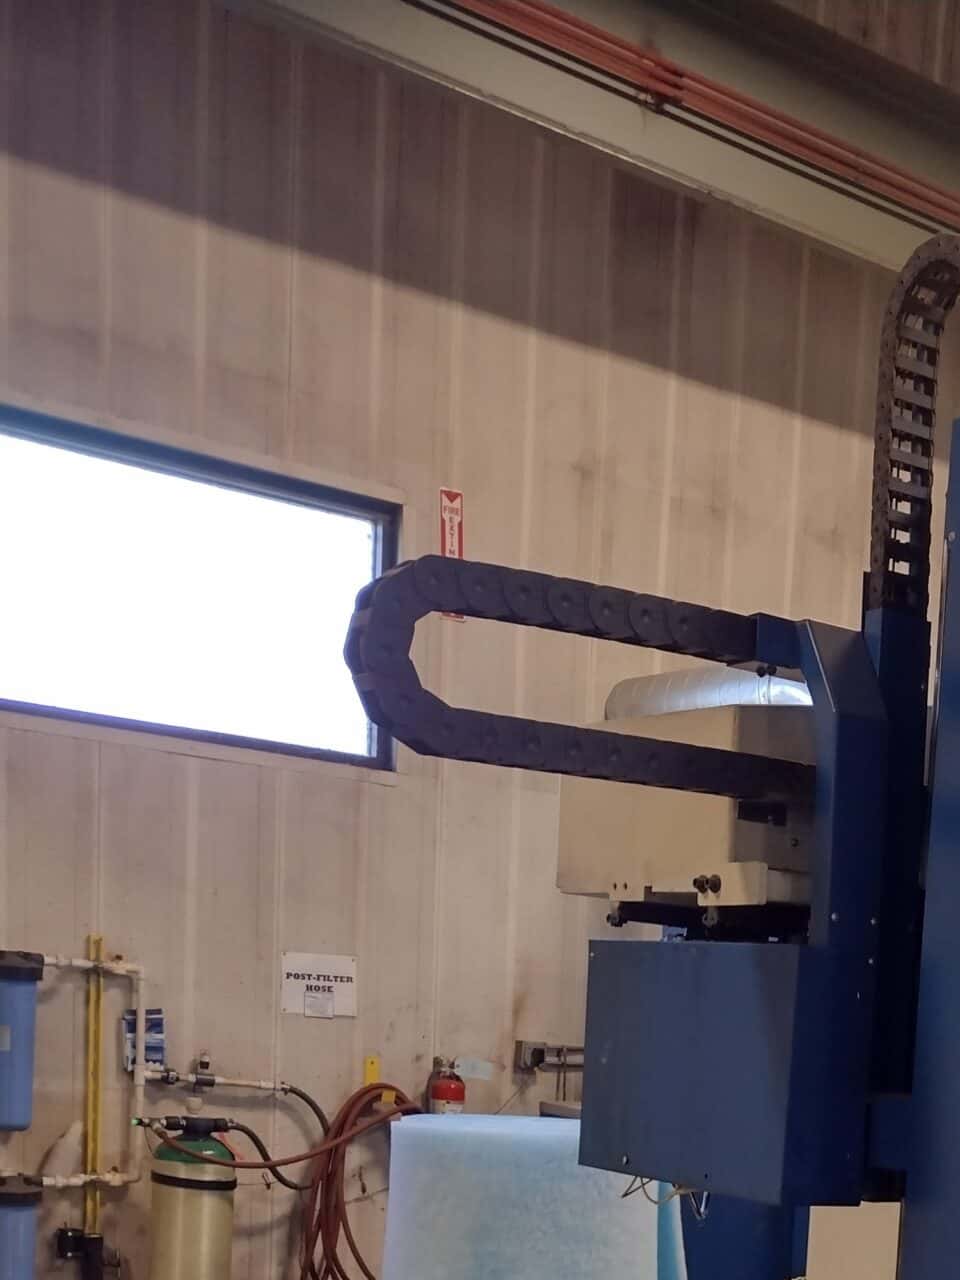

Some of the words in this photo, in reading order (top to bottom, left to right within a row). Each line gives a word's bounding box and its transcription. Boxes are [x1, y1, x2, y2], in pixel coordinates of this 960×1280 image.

[443, 505, 459, 515] FIRE
[285, 971, 354, 984] POST-FILTER
[305, 984, 334, 993] HOSE
